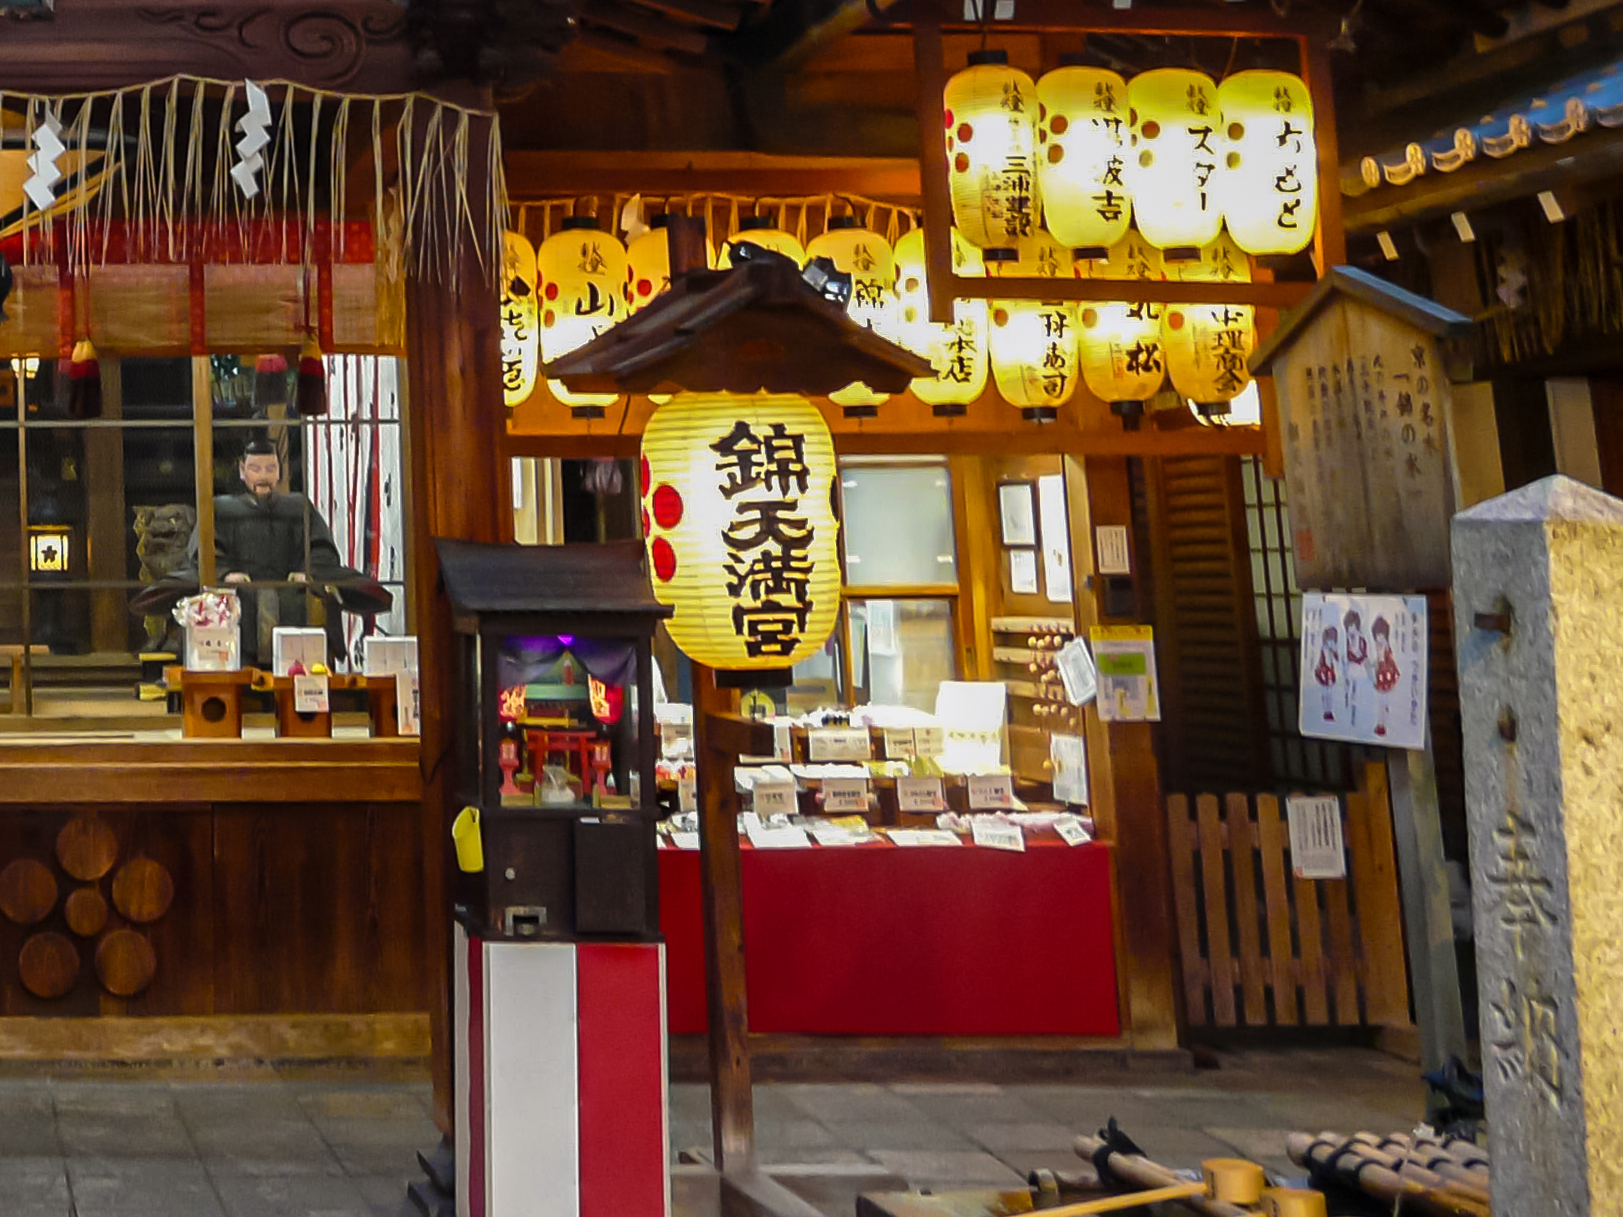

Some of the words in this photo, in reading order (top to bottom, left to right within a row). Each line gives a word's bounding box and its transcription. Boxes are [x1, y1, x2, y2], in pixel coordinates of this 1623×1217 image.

[1188, 125, 1214, 212] スター
[708, 419, 815, 660] 錦天満宮
